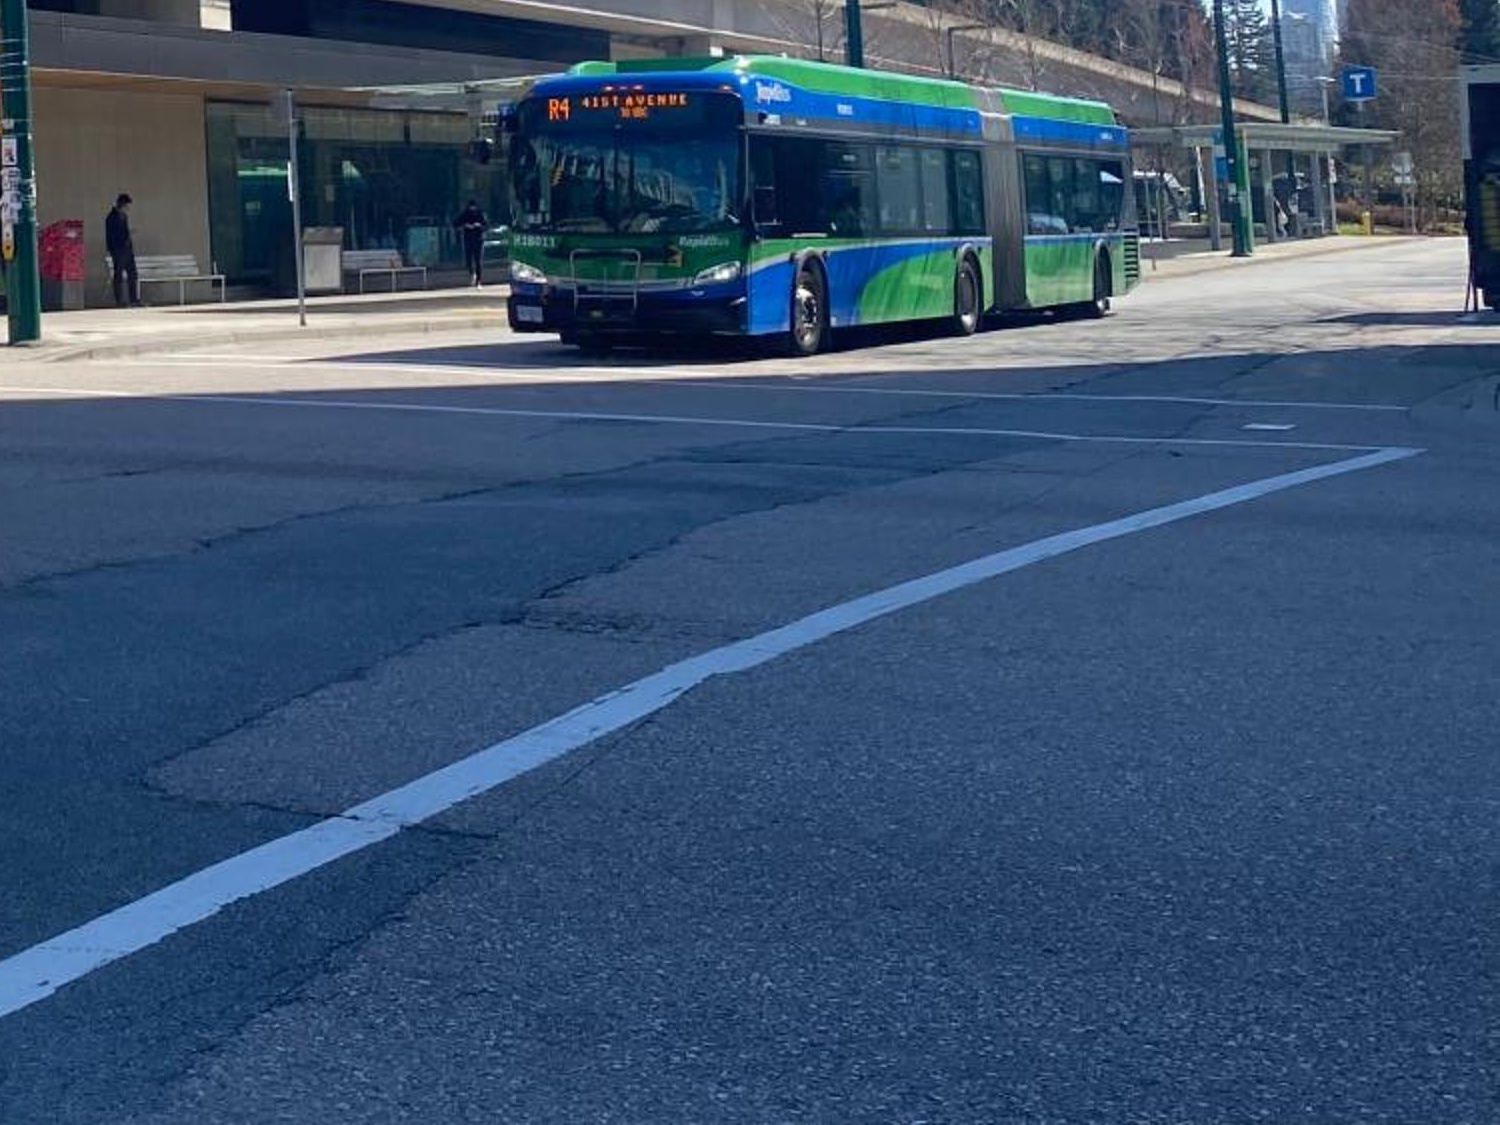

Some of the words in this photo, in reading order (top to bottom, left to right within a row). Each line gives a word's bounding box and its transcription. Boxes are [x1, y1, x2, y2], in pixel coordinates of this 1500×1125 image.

[1349, 74, 1366, 93] T
[549, 93, 570, 121] R4
[581, 96, 618, 108] 41ST
[625, 93, 687, 107] AVENUE
